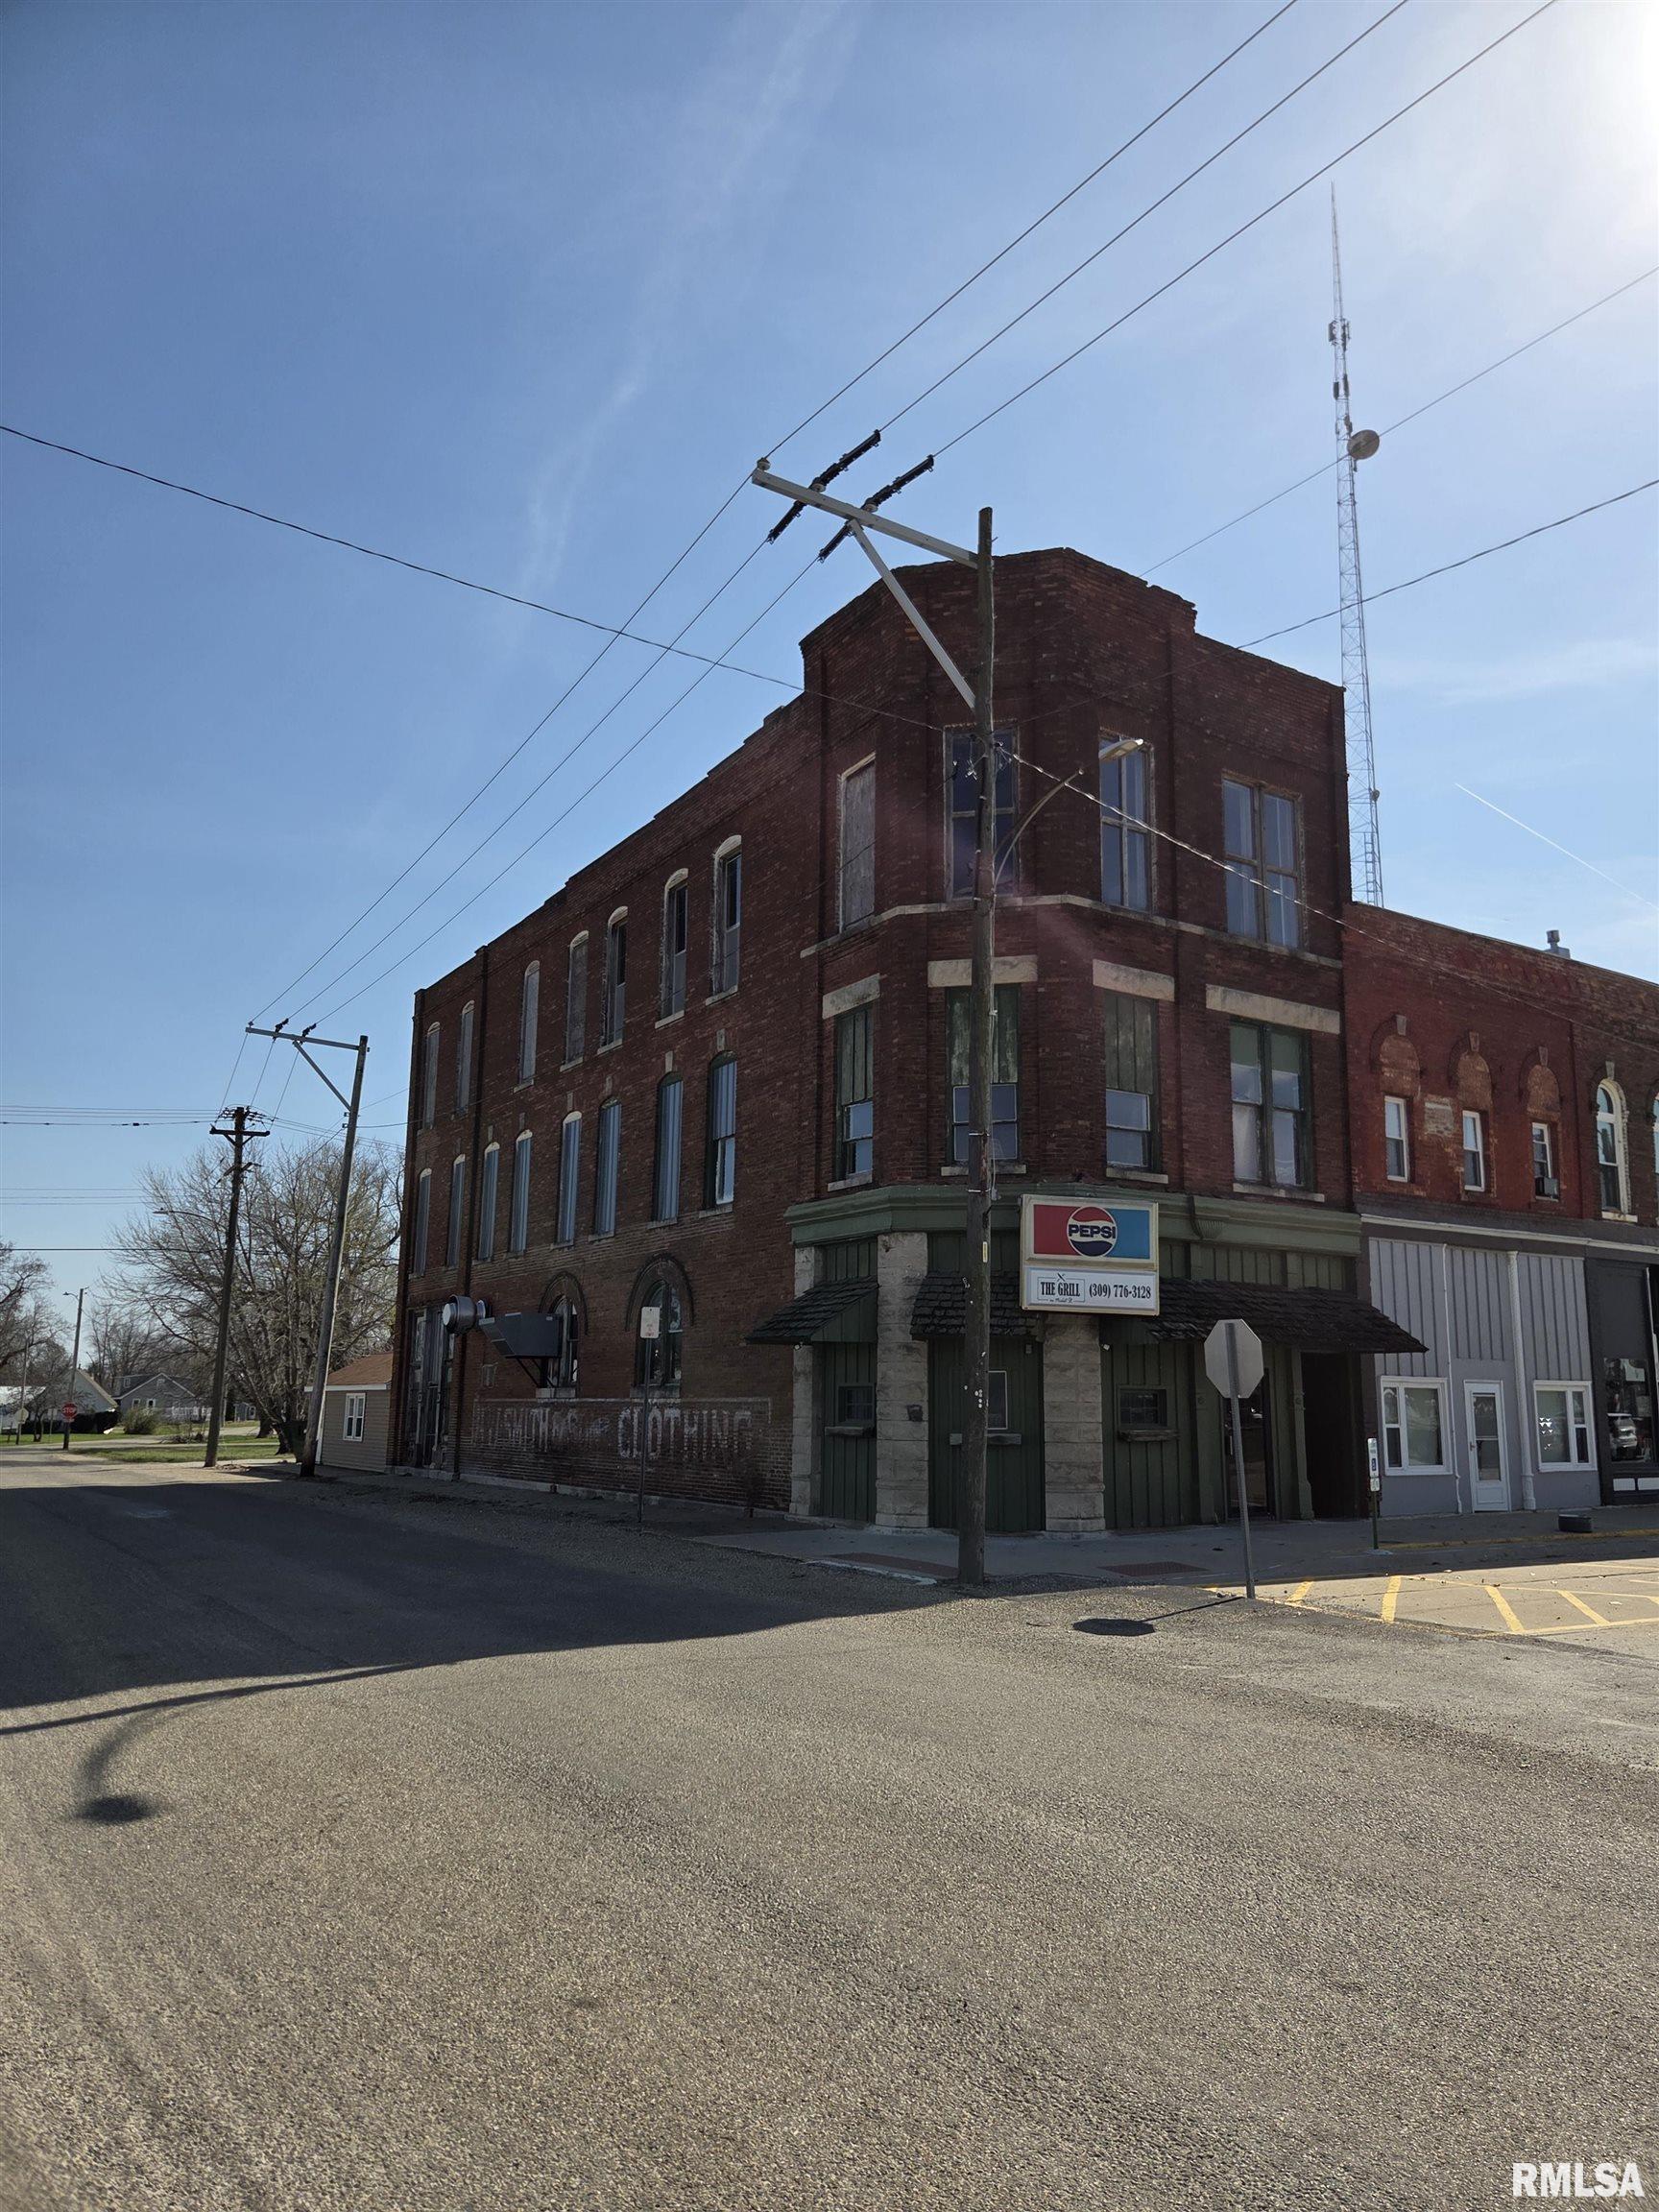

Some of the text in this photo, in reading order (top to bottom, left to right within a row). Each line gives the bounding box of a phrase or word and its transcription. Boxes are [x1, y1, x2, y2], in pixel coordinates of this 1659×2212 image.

[1069, 1224, 1116, 1238] PEPSI
[1041, 1282, 1151, 1299] THE GRILL (309) 776-3128
